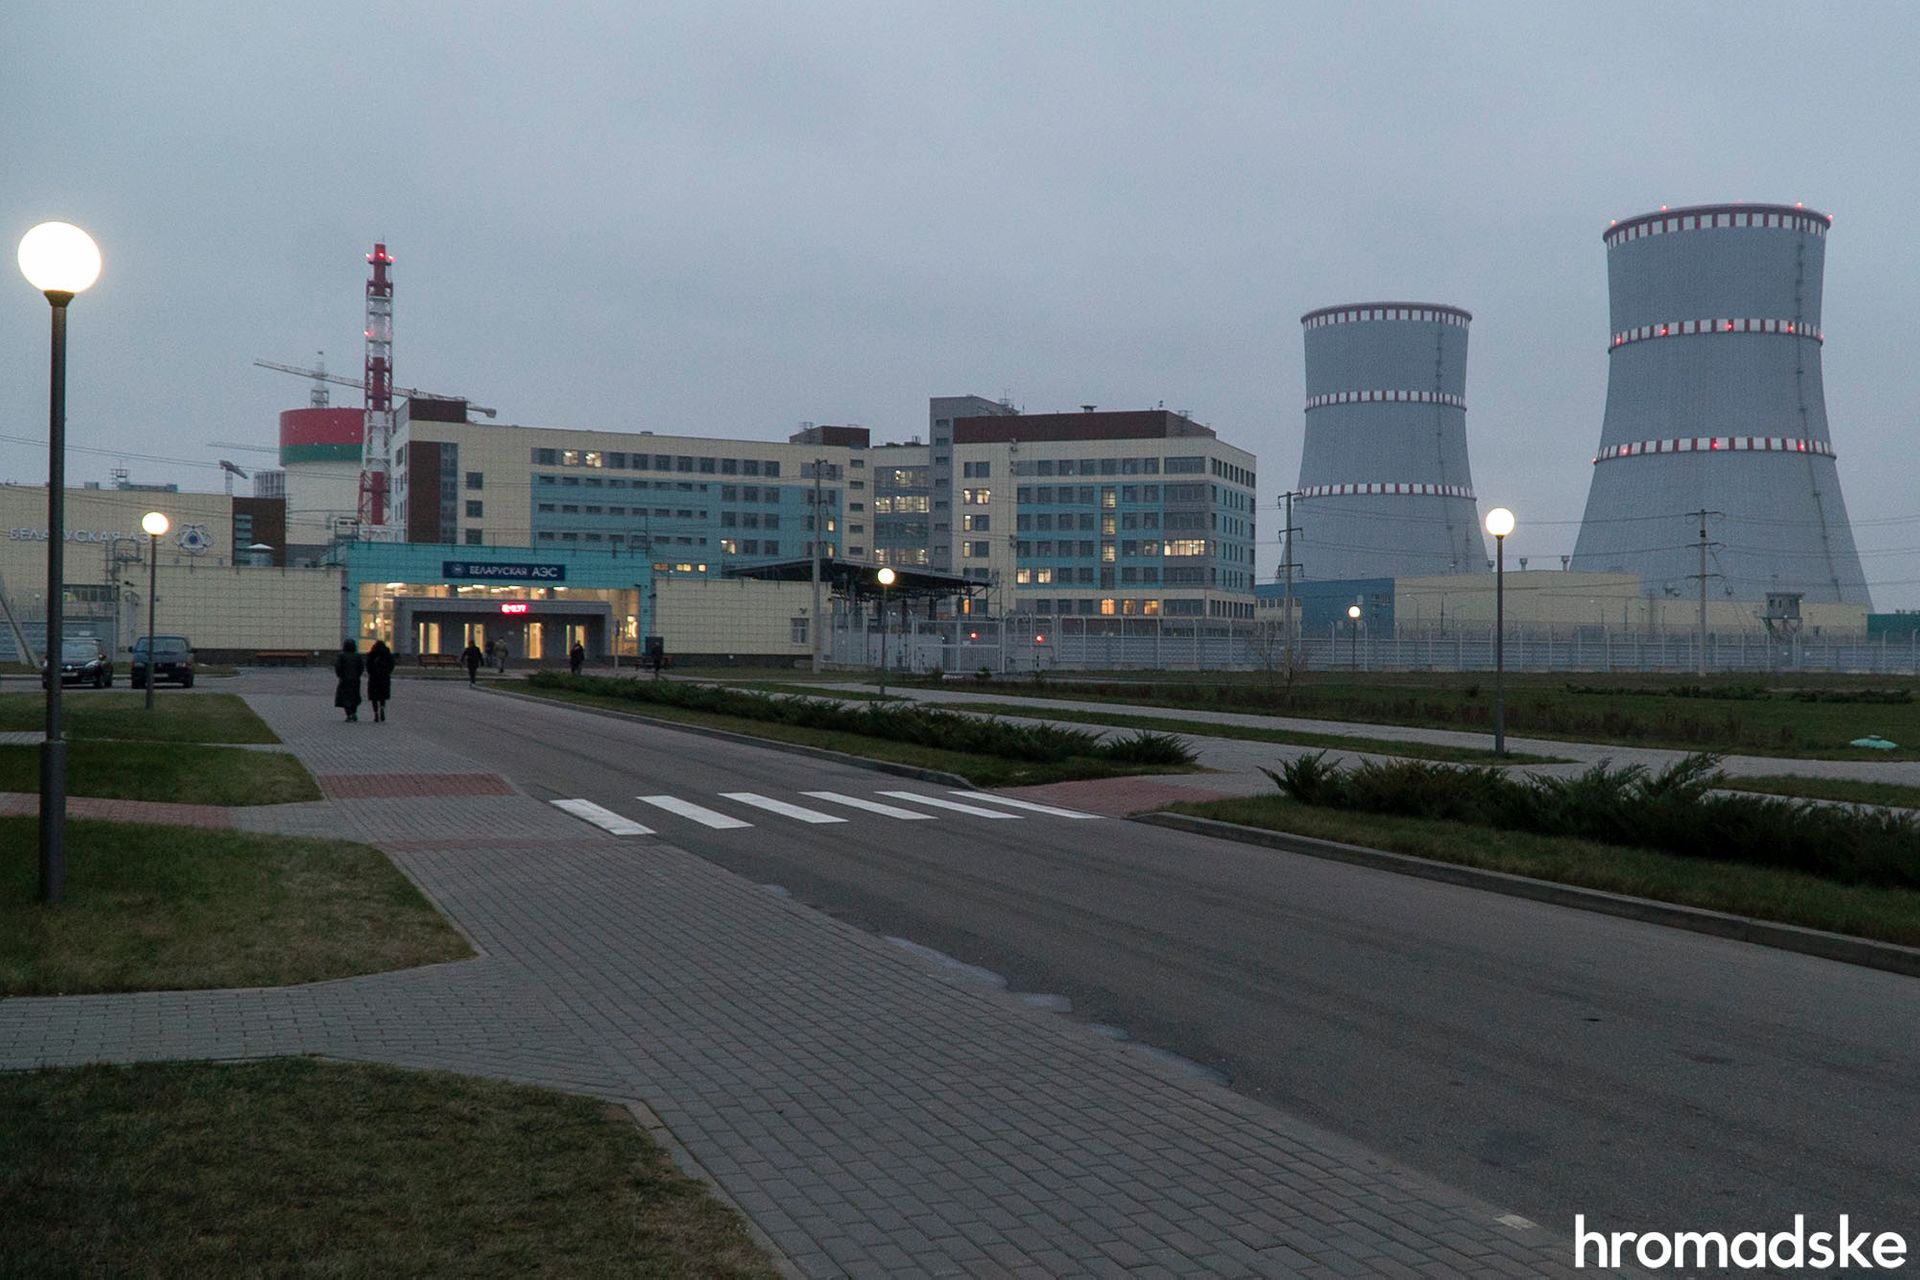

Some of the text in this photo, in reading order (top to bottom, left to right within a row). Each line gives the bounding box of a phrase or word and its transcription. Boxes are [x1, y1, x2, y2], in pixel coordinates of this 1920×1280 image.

[9, 527, 164, 545] БЕЛАУСКАЯ АЭ
[469, 565, 558, 578] БЕЛАРУСКАЯ АЭС
